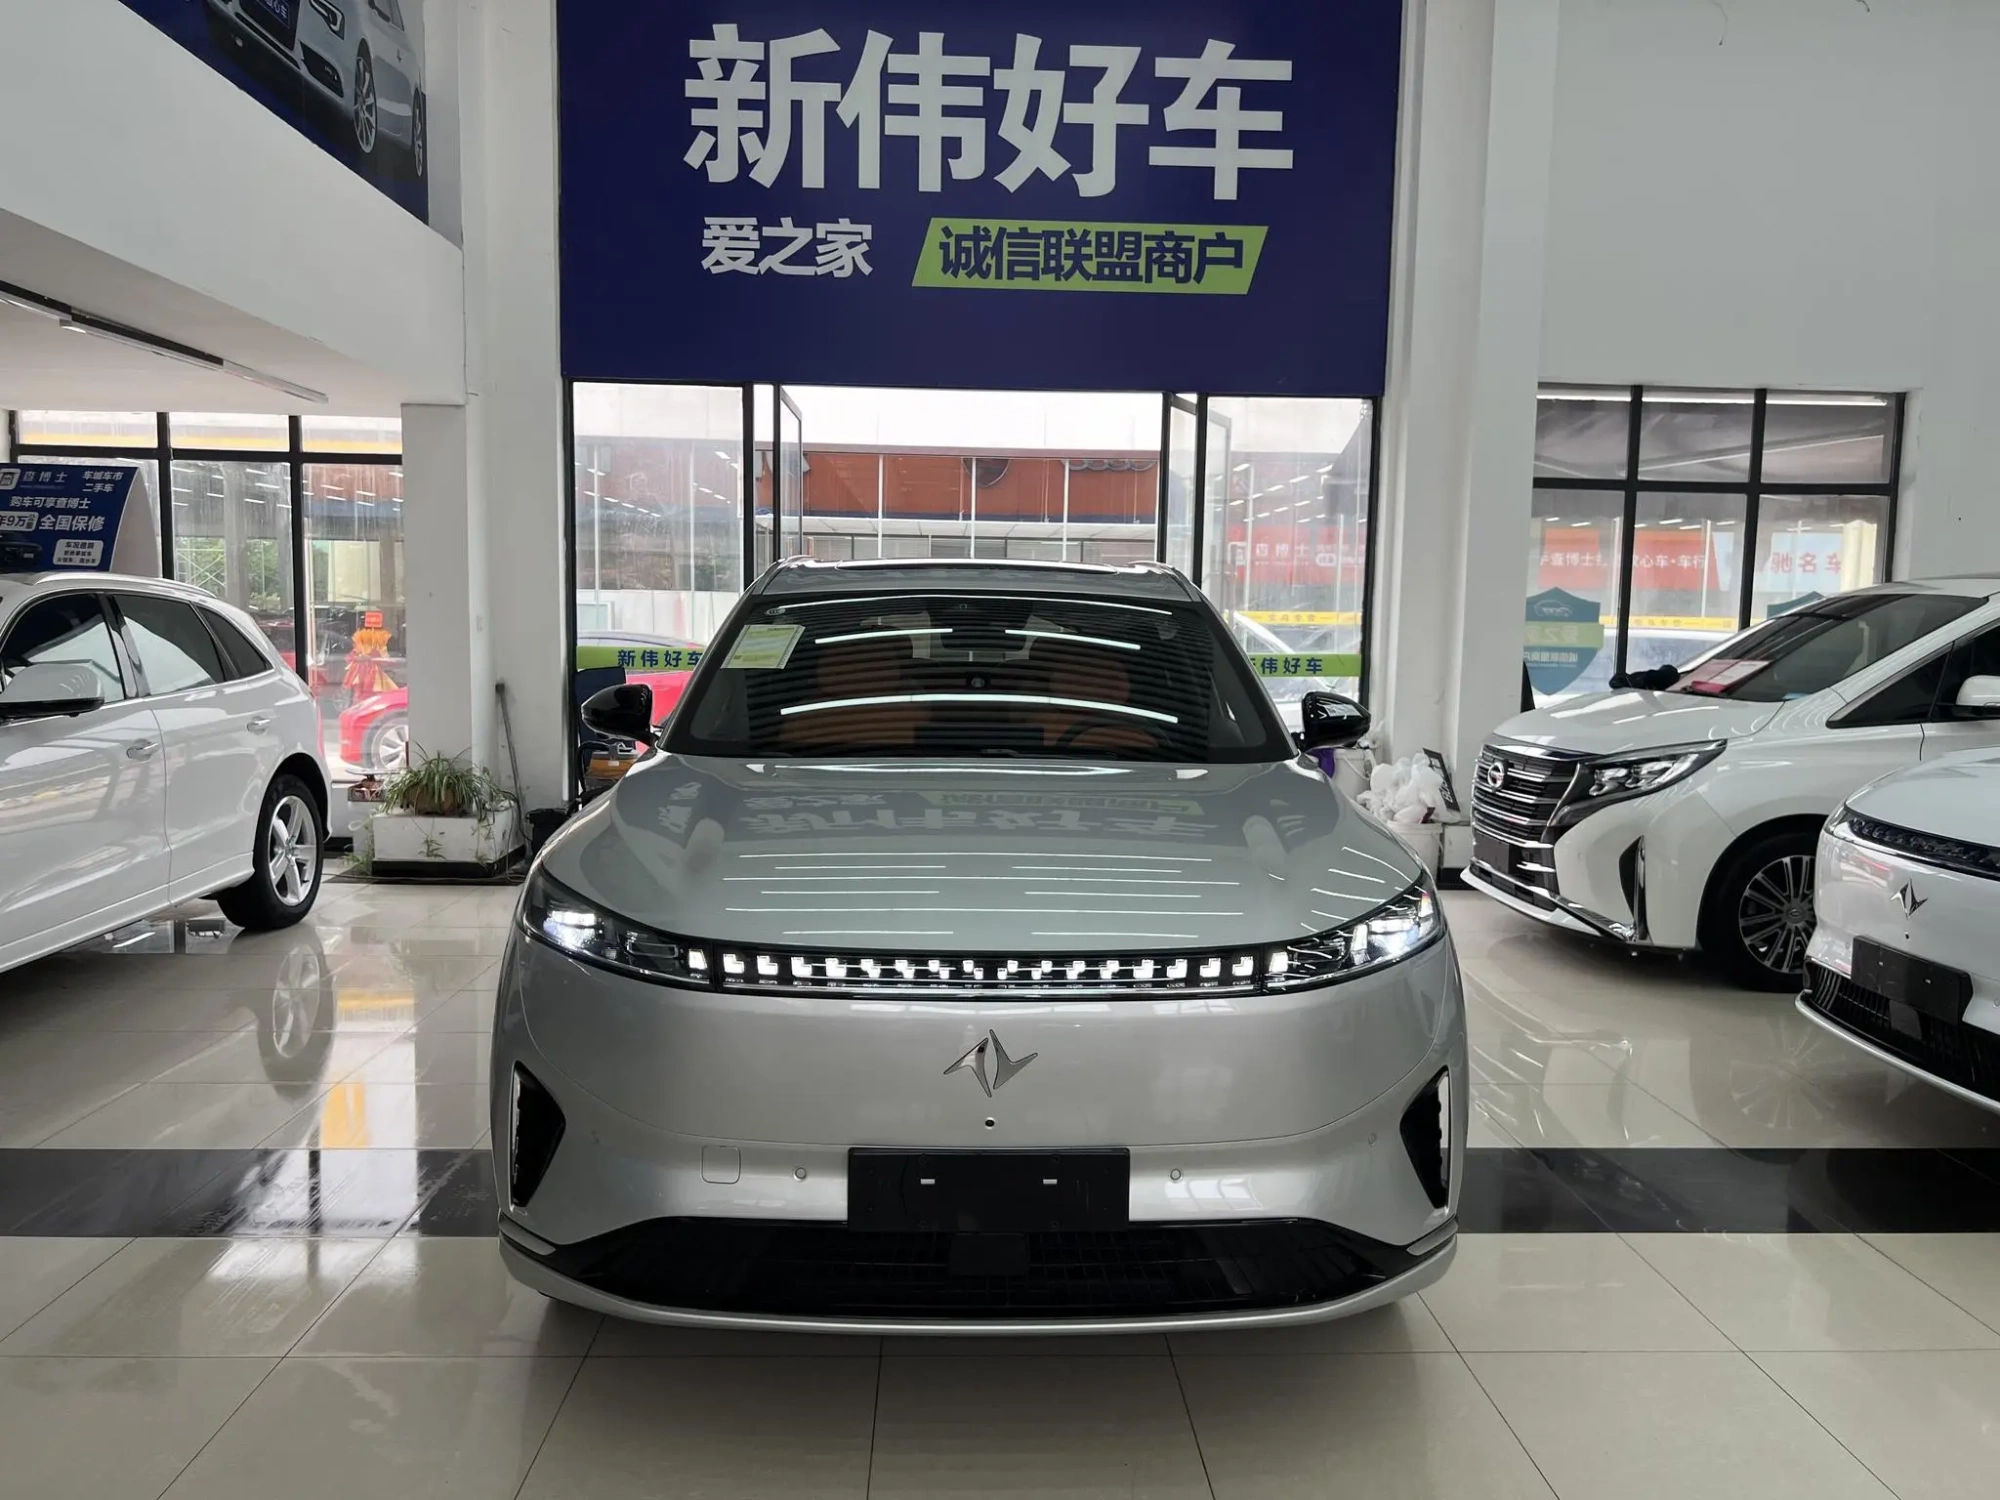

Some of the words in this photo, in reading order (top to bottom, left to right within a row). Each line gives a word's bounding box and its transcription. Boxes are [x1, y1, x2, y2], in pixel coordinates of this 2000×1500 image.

[683, 23, 1294, 201] 新伟好车
[700, 216, 873, 278] 爱之家
[938, 226, 1244, 285] 诚信联盟商户
[82, 483, 115, 493] 二手车
[10, 495, 91, 509] 购车可享查博士
[39, 514, 105, 532] 全国保修
[617, 649, 703, 668] 新伟好车
[1250, 656, 1323, 675] 伟好车
